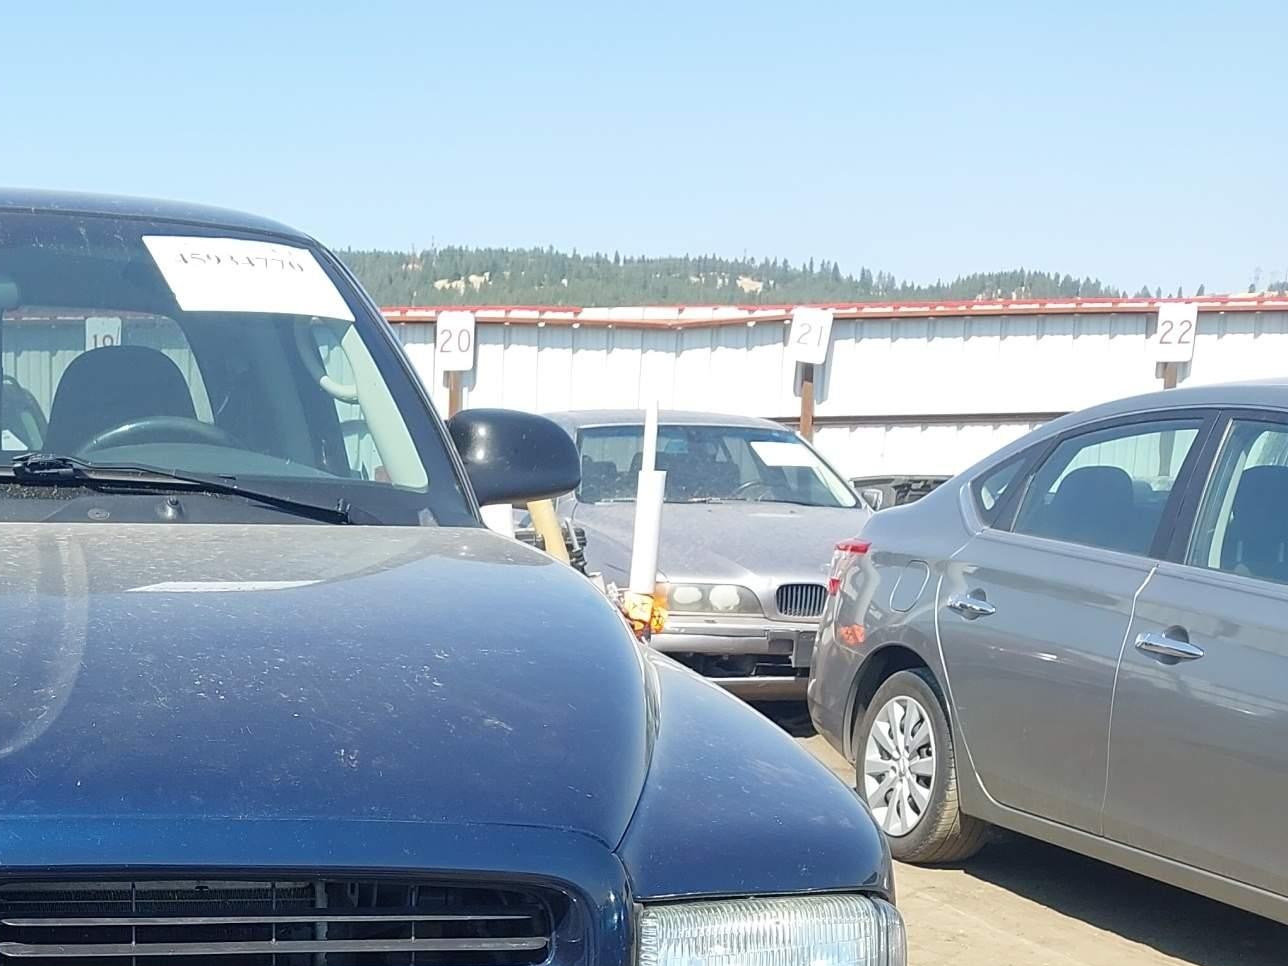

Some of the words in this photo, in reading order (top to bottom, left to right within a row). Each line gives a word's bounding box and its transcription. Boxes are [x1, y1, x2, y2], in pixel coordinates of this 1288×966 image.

[440, 328, 470, 352] 20
[797, 322, 823, 346] 21
[1159, 320, 1192, 344] 22
